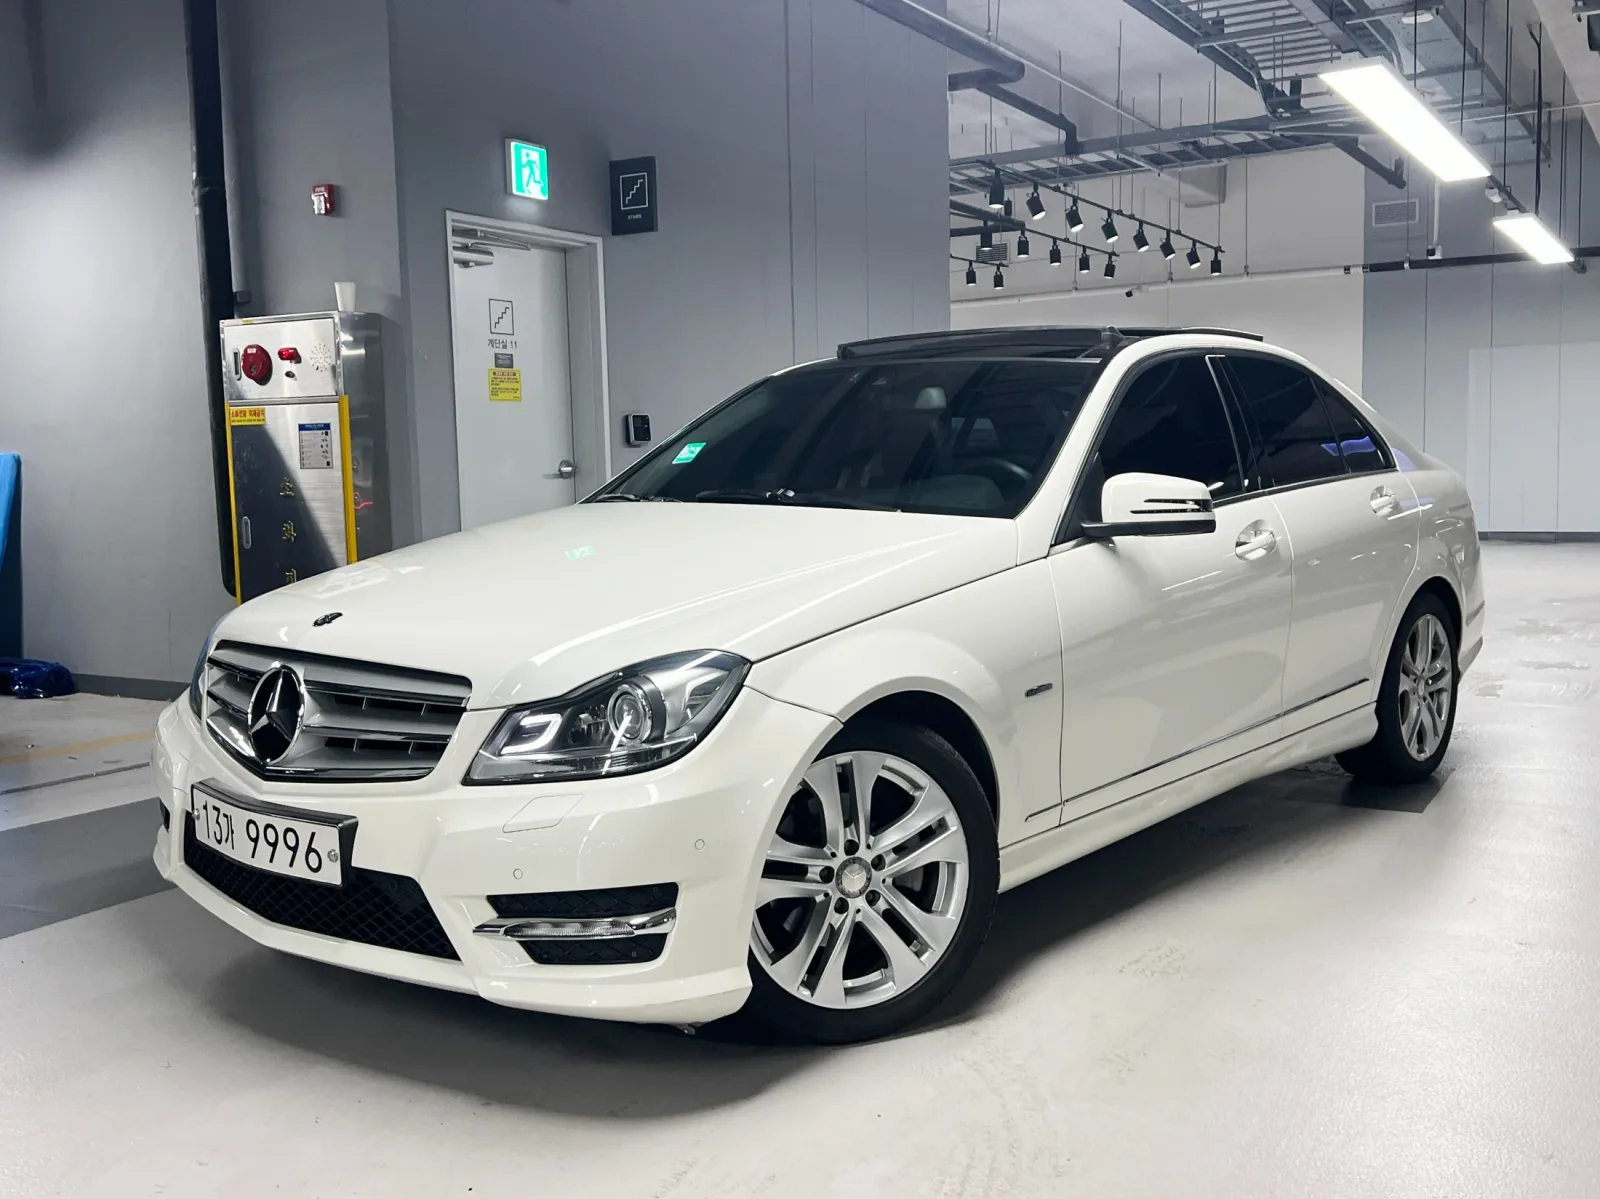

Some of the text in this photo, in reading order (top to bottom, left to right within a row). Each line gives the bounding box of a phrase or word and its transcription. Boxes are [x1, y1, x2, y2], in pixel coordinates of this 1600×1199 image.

[488, 338, 517, 349] 계단실 11
[203, 800, 322, 873] 13가 9996
